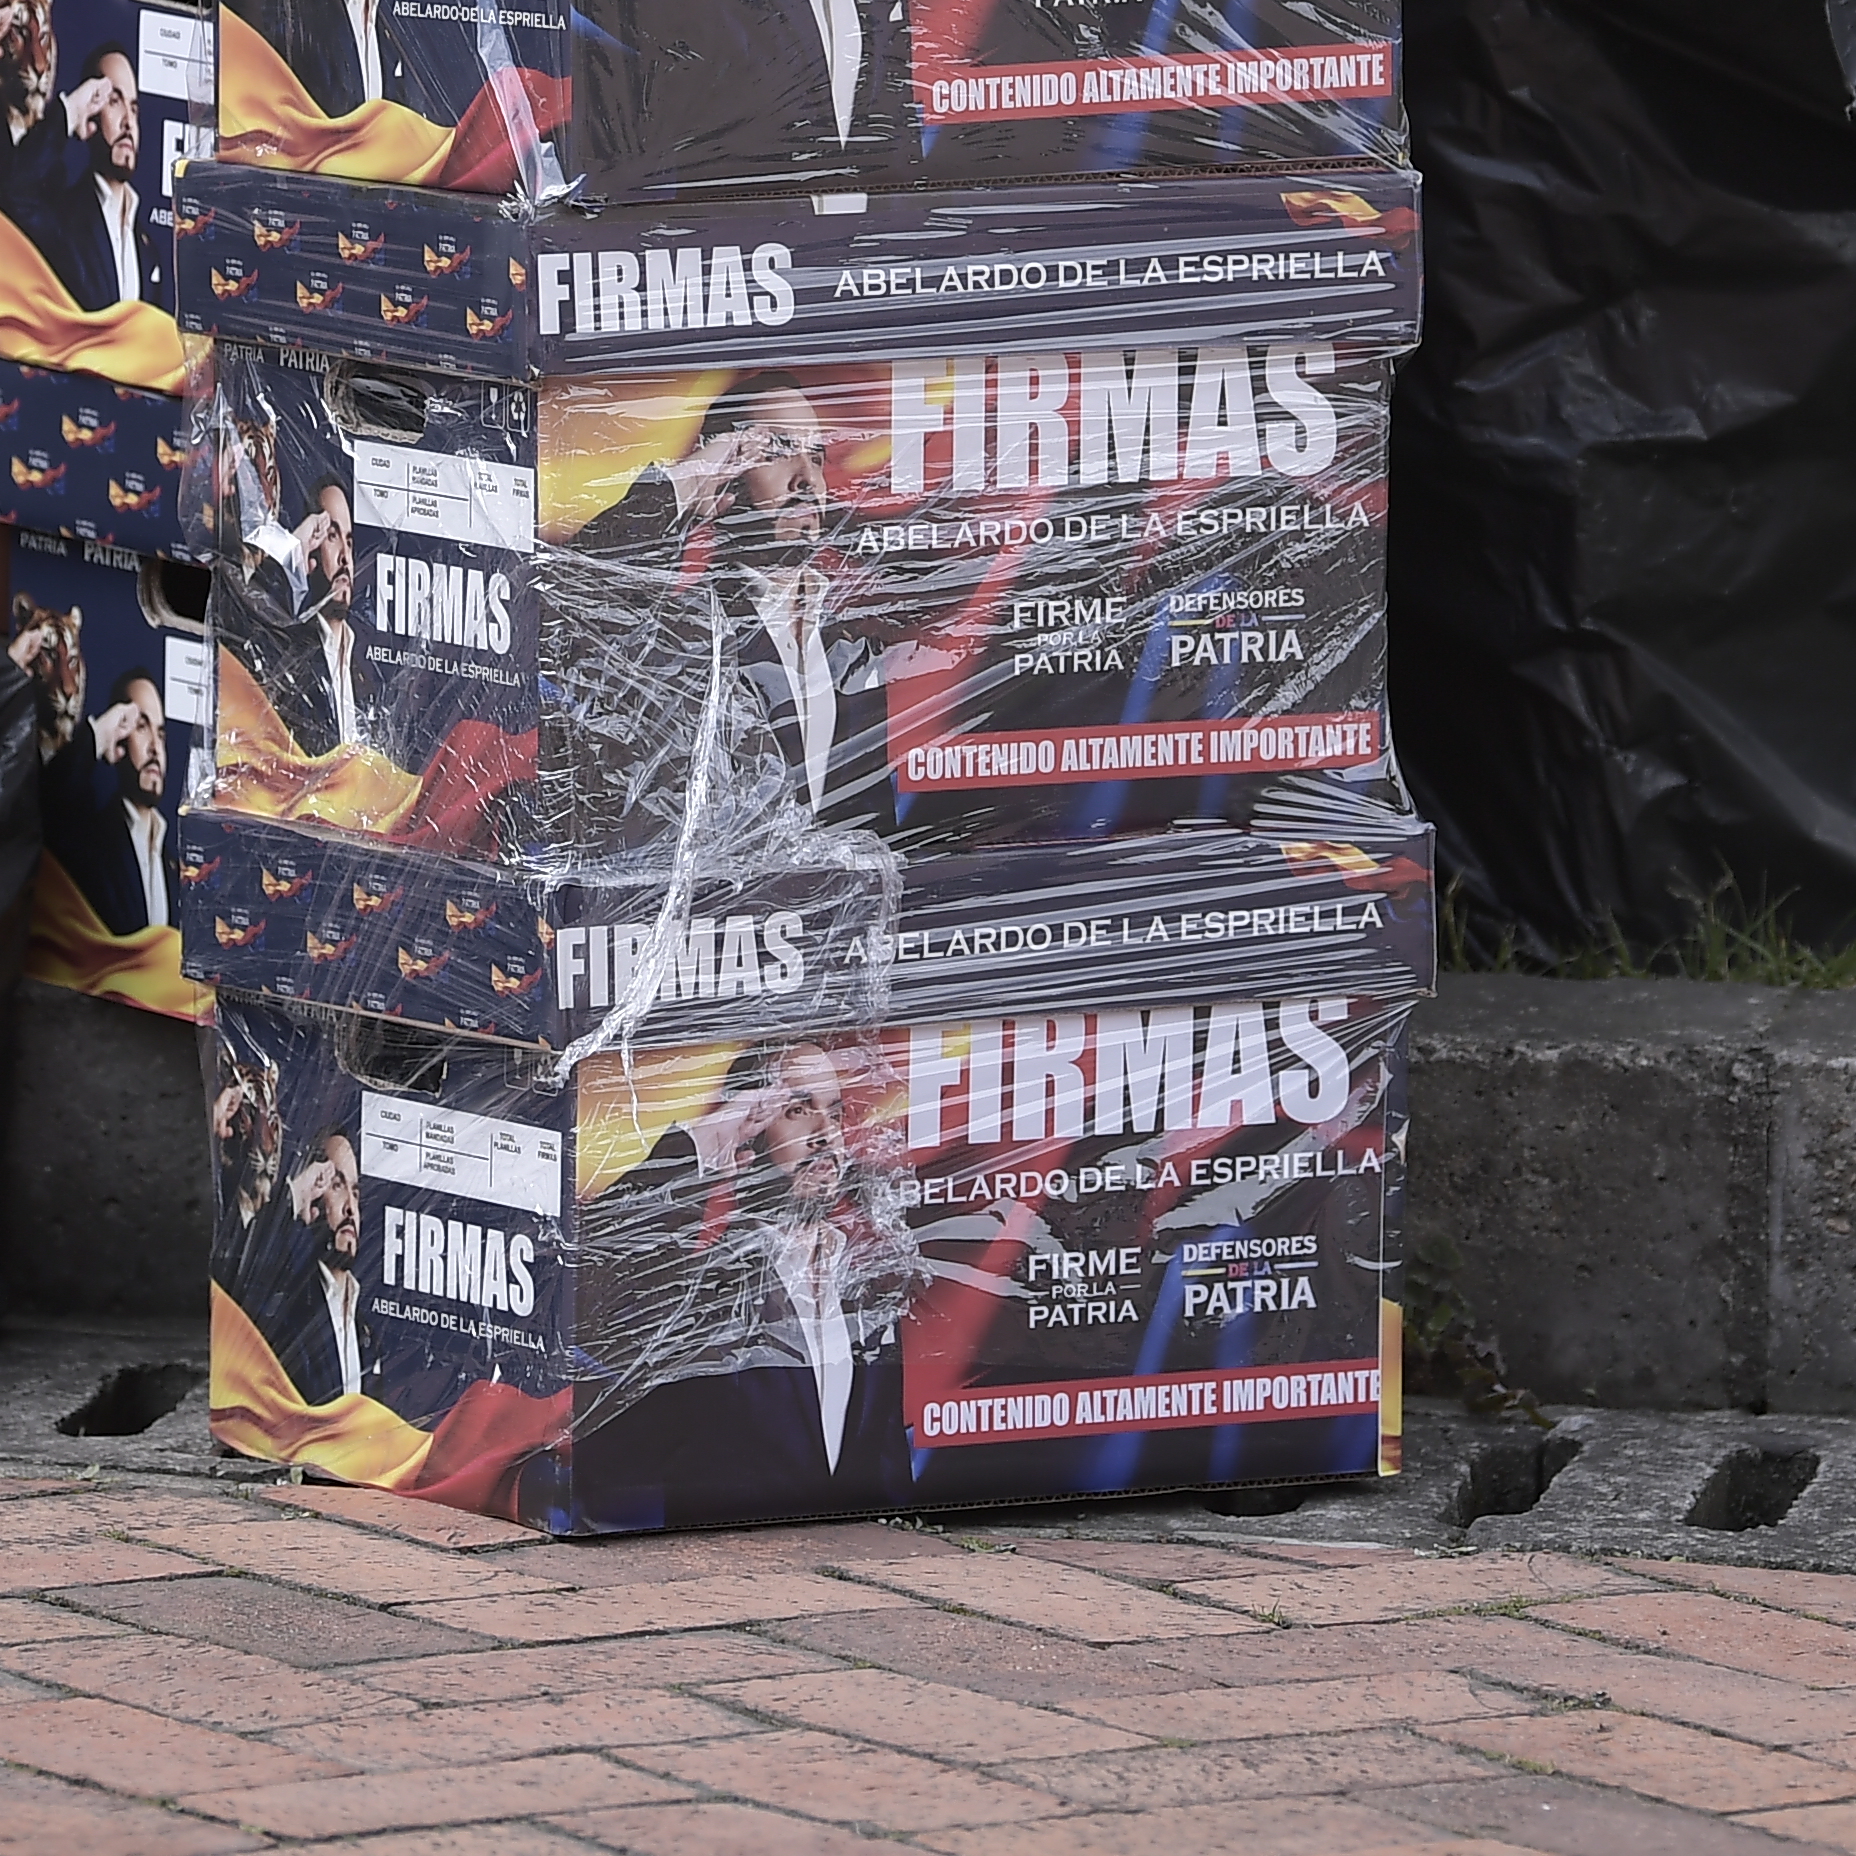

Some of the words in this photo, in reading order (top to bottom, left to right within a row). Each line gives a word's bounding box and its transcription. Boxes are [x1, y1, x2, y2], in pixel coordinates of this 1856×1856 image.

[392, 1, 458, 21] ABELARDO
[460, 6, 478, 23] DE
[479, 9, 496, 25] LA
[499, 10, 566, 30] ESPRIELLA
[931, 72, 1079, 115] CONTENIDO
[1083, 61, 1223, 106] ALTAMENTE
[1227, 53, 1386, 99] IMPORTANTE
[538, 242, 795, 336] FIRMAS
[833, 262, 1051, 299] ABELARDO
[1058, 259, 1109, 289] DE
[1118, 256, 1167, 286] LA
[1175, 249, 1386, 284] ESPRIELLA
[224, 343, 264, 364] PATRIA
[890, 342, 1340, 497] FIRMAS
[856, 519, 1056, 555] ABELARDO
[1064, 514, 1113, 545] DE
[1120, 510, 1168, 540] LA
[1175, 502, 1372, 537] ESPRIELLA
[20, 532, 67, 557] PATRIA
[83, 540, 141, 572] PATRIA
[376, 553, 511, 655] FIRMAS
[1013, 596, 1127, 629] FIRME
[1169, 588, 1305, 614] DEFENSORES
[1215, 614, 1236, 628] DE
[1240, 613, 1259, 627] LA
[1037, 632, 1074, 646] POR
[1078, 630, 1101, 645] LA
[1170, 629, 1305, 667] PATRIA
[428, 657, 444, 673] DE
[445, 660, 460, 677] LA
[461, 662, 522, 688] ESPRIELLA
[1014, 649, 1125, 676] PATRIA
[906, 746, 1056, 782] CONTENIDO
[1060, 735, 1204, 774] ALTAMENTE
[1209, 722, 1374, 764] IMPORTANTE
[1062, 919, 1113, 949] DE
[1121, 915, 1170, 945] LA
[1176, 903, 1385, 941] ESPRIELLA
[907, 996, 1351, 1149] FIRMAS
[1079, 1165, 1128, 1196] DE
[1134, 1162, 1183, 1191] LA
[1189, 1146, 1383, 1188] ESPRIELLA
[383, 1205, 535, 1317] FIRMAS
[1028, 1246, 1142, 1282] FIRME
[1182, 1235, 1318, 1264] DEFENSORES
[1228, 1263, 1248, 1278] DE
[1253, 1262, 1272, 1276] LA
[1052, 1285, 1087, 1300] POR
[1092, 1282, 1117, 1297] LA
[1184, 1276, 1317, 1318] PATRIA
[371, 1297, 438, 1326] ABELARDO
[441, 1312, 457, 1331] DE
[459, 1316, 476, 1336] LA
[478, 1321, 546, 1353] ESPRIELLA
[1029, 1299, 1139, 1329] PATRIA
[922, 1394, 1071, 1438] CONTENIDO
[1074, 1381, 1218, 1428] ALTAMENTE
[1221, 1370, 1383, 1416] IMPORTANTE
